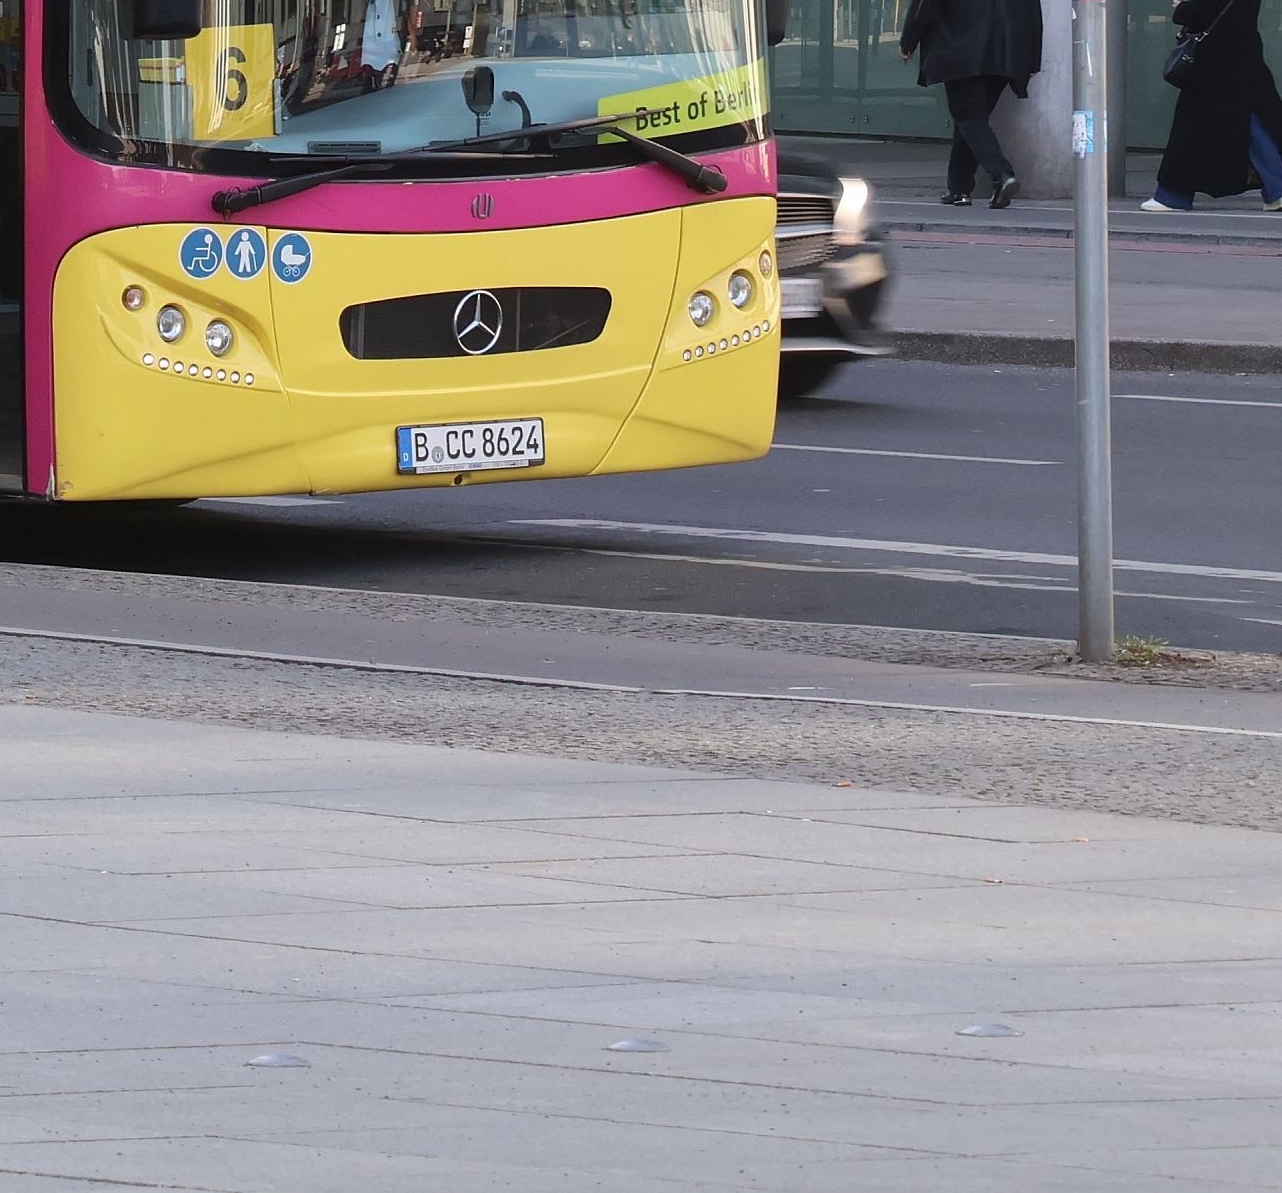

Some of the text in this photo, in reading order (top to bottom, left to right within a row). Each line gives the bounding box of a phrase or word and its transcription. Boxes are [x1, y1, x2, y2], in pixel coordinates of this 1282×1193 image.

[216, 46, 248, 112] 6
[635, 79, 758, 132] Best of Berli
[414, 425, 540, 463] B CC 8624
